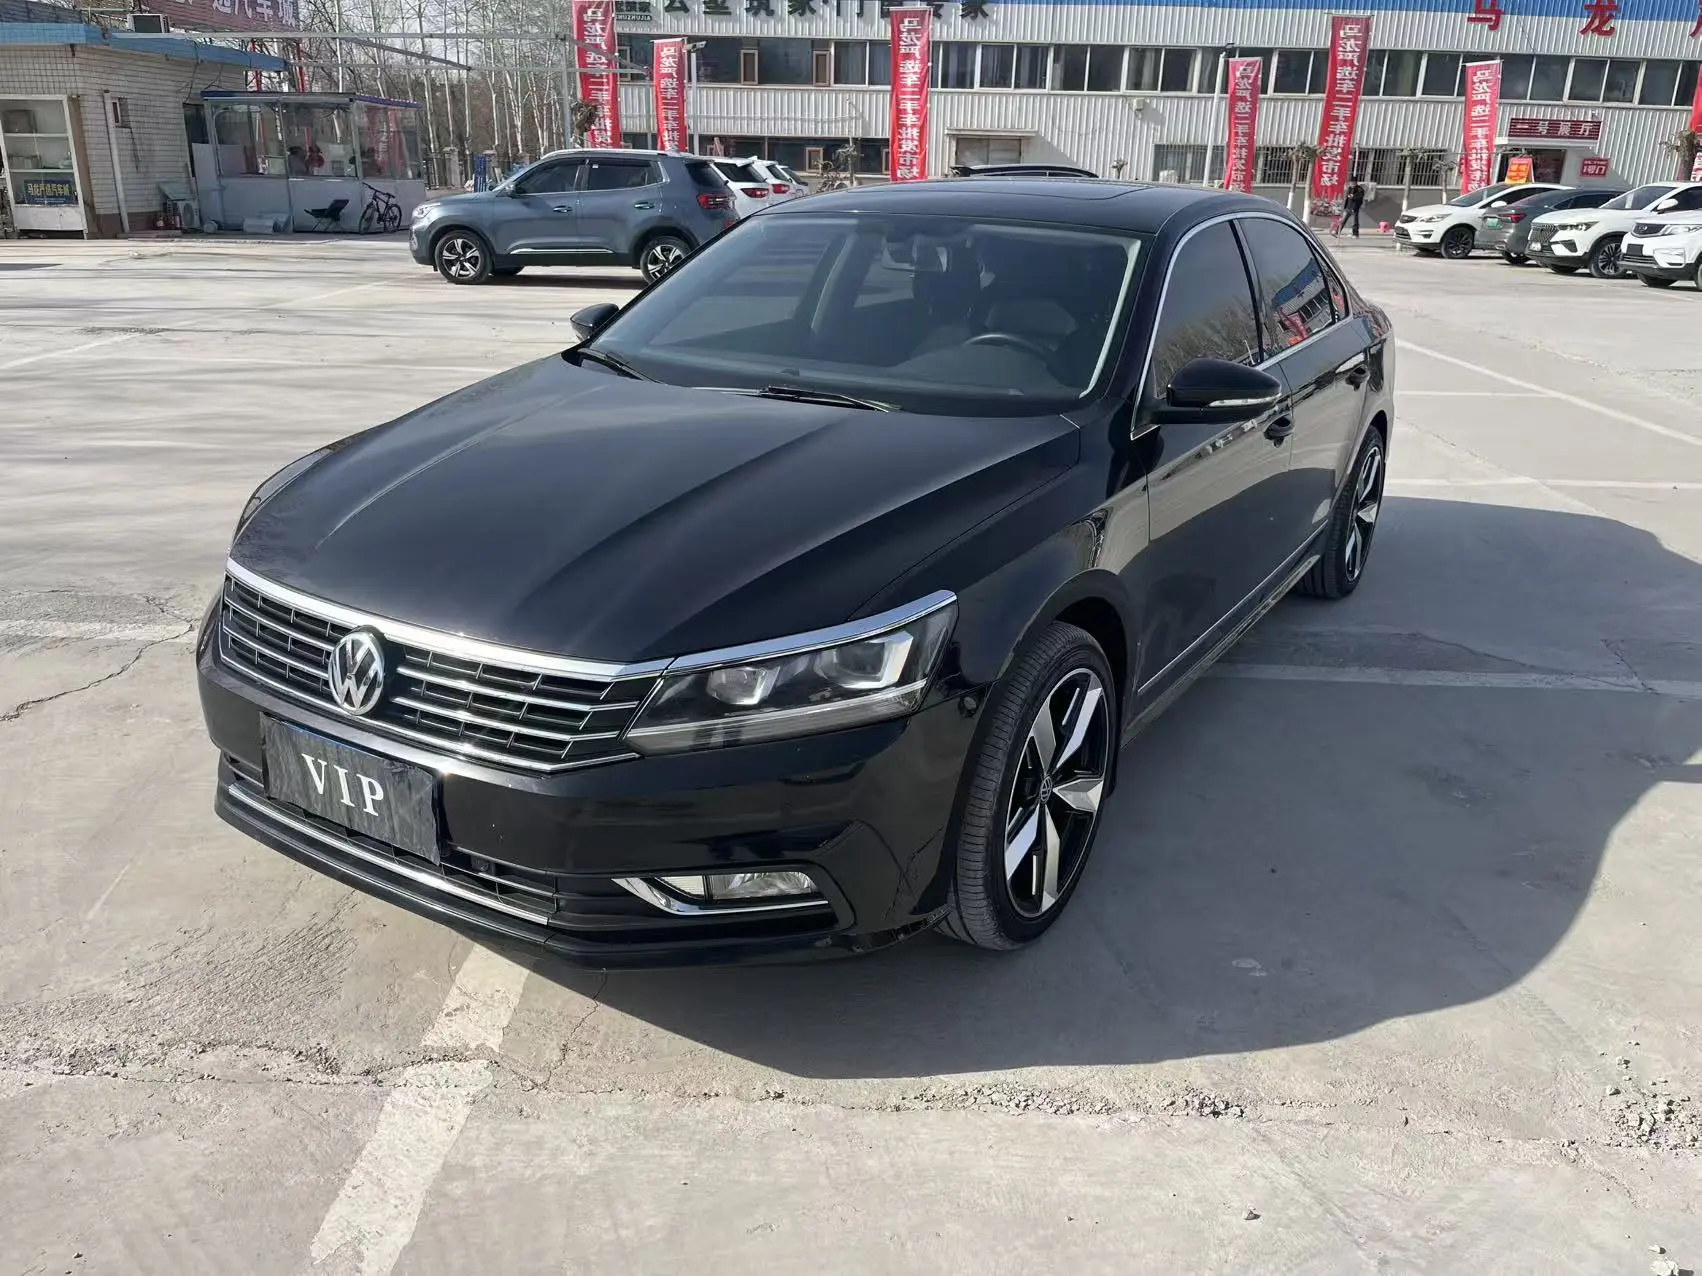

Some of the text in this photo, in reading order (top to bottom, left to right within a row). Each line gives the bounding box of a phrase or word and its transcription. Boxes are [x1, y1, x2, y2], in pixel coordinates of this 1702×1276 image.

[1516, 121, 1594, 136] 一号展厅
[301, 753, 385, 817] VIP
